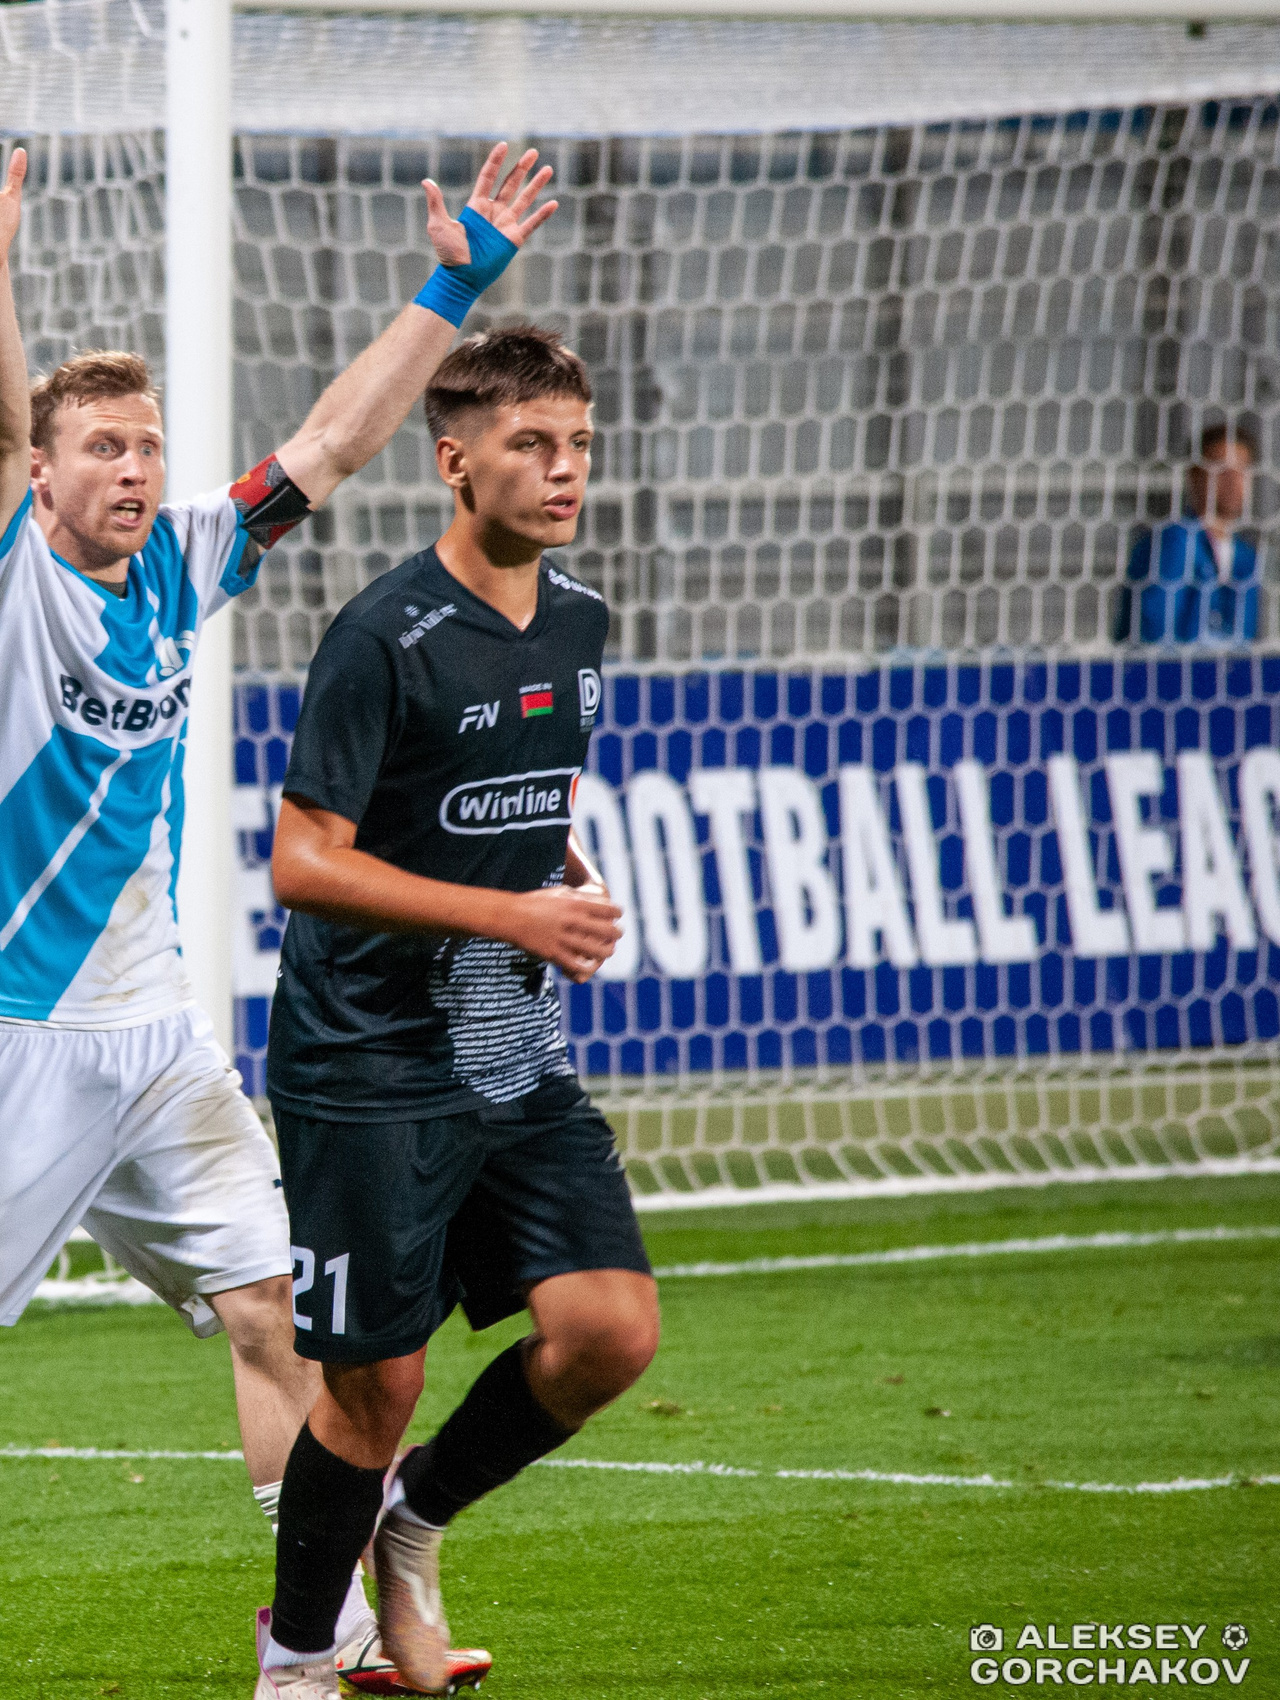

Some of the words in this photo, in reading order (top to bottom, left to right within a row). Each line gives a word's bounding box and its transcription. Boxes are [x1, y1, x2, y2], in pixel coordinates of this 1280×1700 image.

[458, 701, 501, 734] FN
[573, 757, 1038, 981] OOTBALL
[290, 1245, 350, 1335] 21
